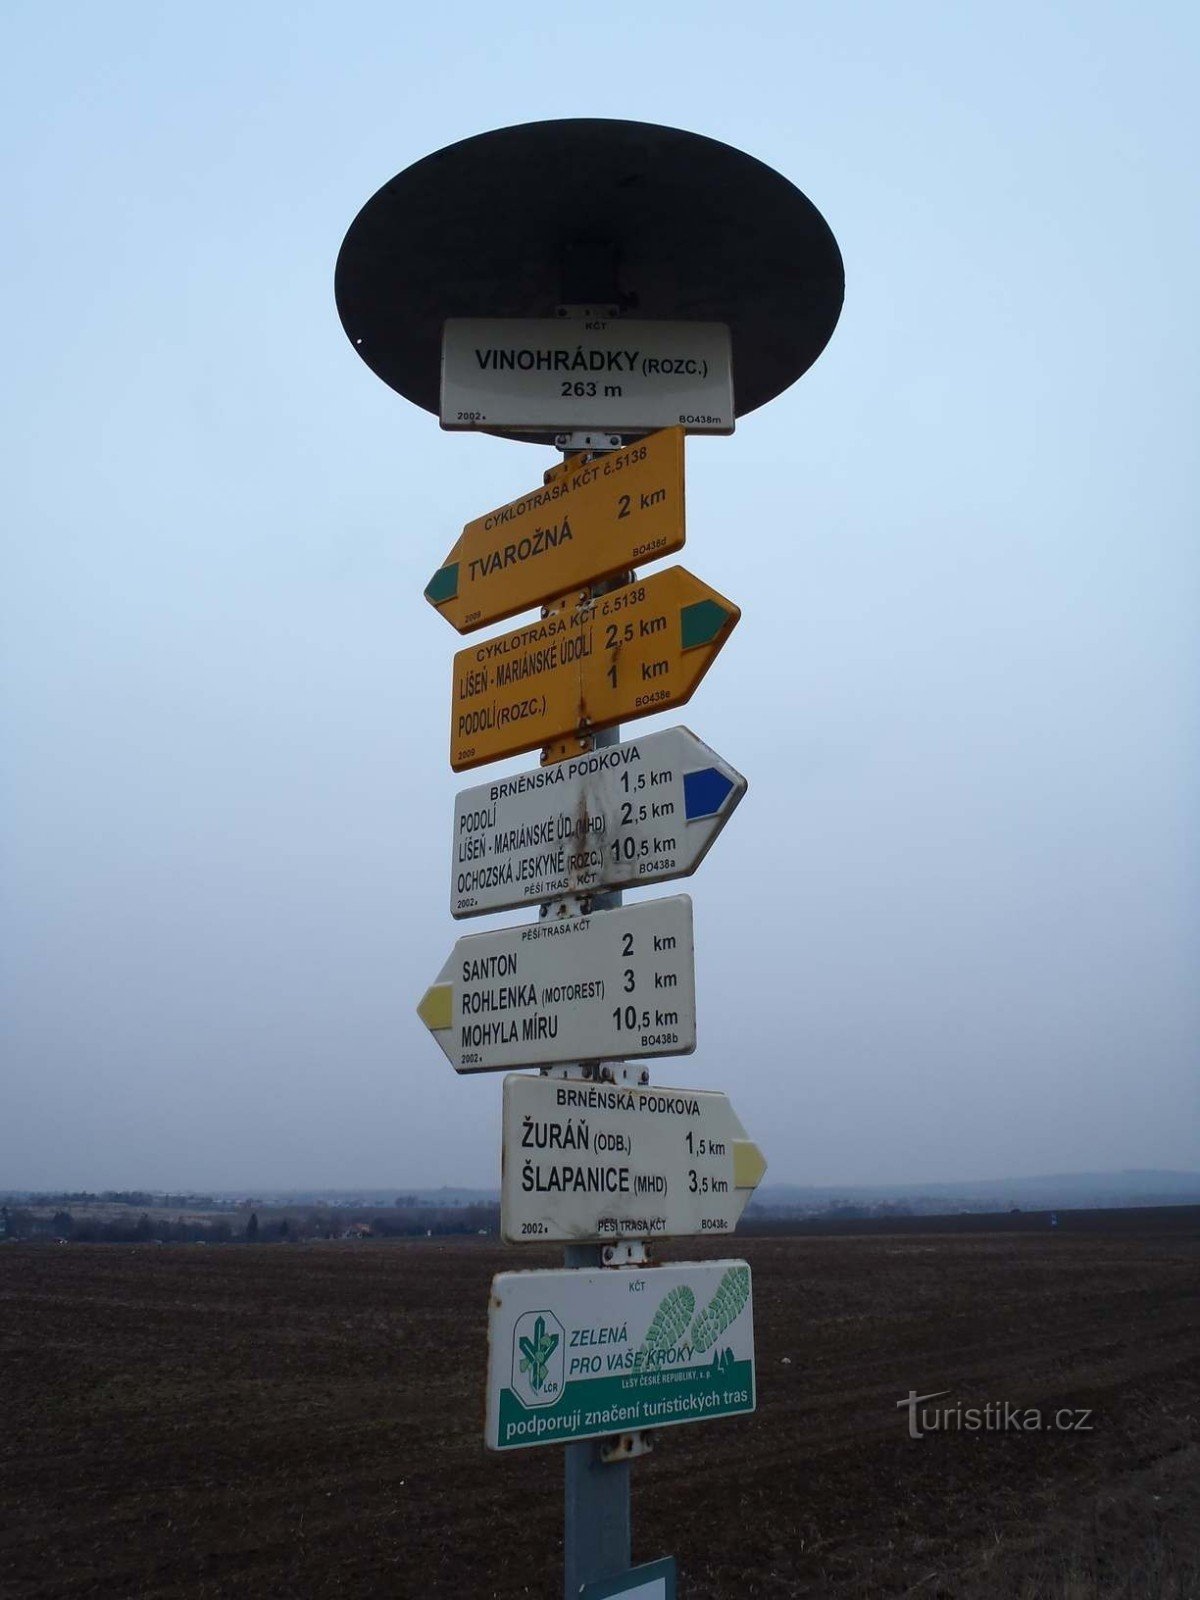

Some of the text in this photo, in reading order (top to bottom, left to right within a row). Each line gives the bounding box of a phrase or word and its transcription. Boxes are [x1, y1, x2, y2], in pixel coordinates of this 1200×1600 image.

[585, 321, 607, 331] KČT
[475, 345, 708, 378] VINOHRÁDKY (ROZC.)
[561, 381, 622, 397] 263 m
[679, 414, 721, 424] BO438m
[484, 445, 647, 531] CYKLOTRASA KČT č.5138
[468, 487, 666, 582] TVAROŽNÁ 2 km
[476, 587, 646, 662] CYKLOTRASA KČT č.5138
[460, 665, 488, 700] LÍŠEŇ
[496, 642, 557, 688] MARIÁNSKÉ
[561, 632, 593, 667] ÚDOLÍ
[605, 624, 634, 650] 2,5
[639, 615, 667, 637] km
[607, 664, 618, 689] 1
[641, 659, 669, 681] km
[458, 748, 475, 760] 2009
[490, 746, 641, 801] BRNĚNSKÁ PODKOVA
[460, 768, 673, 834] PODOLÍ 1,5 km
[459, 834, 487, 863] LÍŠEŇ
[494, 817, 554, 855] MARIÁNSKÉ
[621, 802, 647, 825] 2,5
[652, 801, 674, 818] km
[457, 836, 676, 894] OCHOZSKÁ JESKYNĚ (ROZC.) 10,5 km
[639, 860, 676, 874] BO438a
[524, 870, 597, 895] PĚŠÍ TRAS KČT
[522, 919, 590, 942] PĚŠÍ TRASA KČT
[462, 932, 676, 982] SANTON 2 km
[462, 969, 678, 1015] ROHLENKA (MOTOREST) 3 km
[461, 1005, 678, 1048] MOHYLA MÍRU 10,5 km
[641, 1034, 678, 1047] BO438b
[556, 1087, 700, 1116] BRNĚNSKÁ PODKOVA
[521, 1115, 726, 1157] ŽURÁŇ (ODB.) 1,5 km
[521, 1159, 728, 1197] ŠLAPANICE (MHD) 3,5 km
[597, 1218, 667, 1232] PĚŠÍ TRASA KČT
[628, 1280, 647, 1292] KČT
[569, 1321, 628, 1347] ZELENÁ
[569, 1345, 695, 1375] PRO VAŠE KROKY
[639, 1373, 661, 1386] ČESKÉ
[506, 1388, 748, 1439] podporují značení turistických tras
